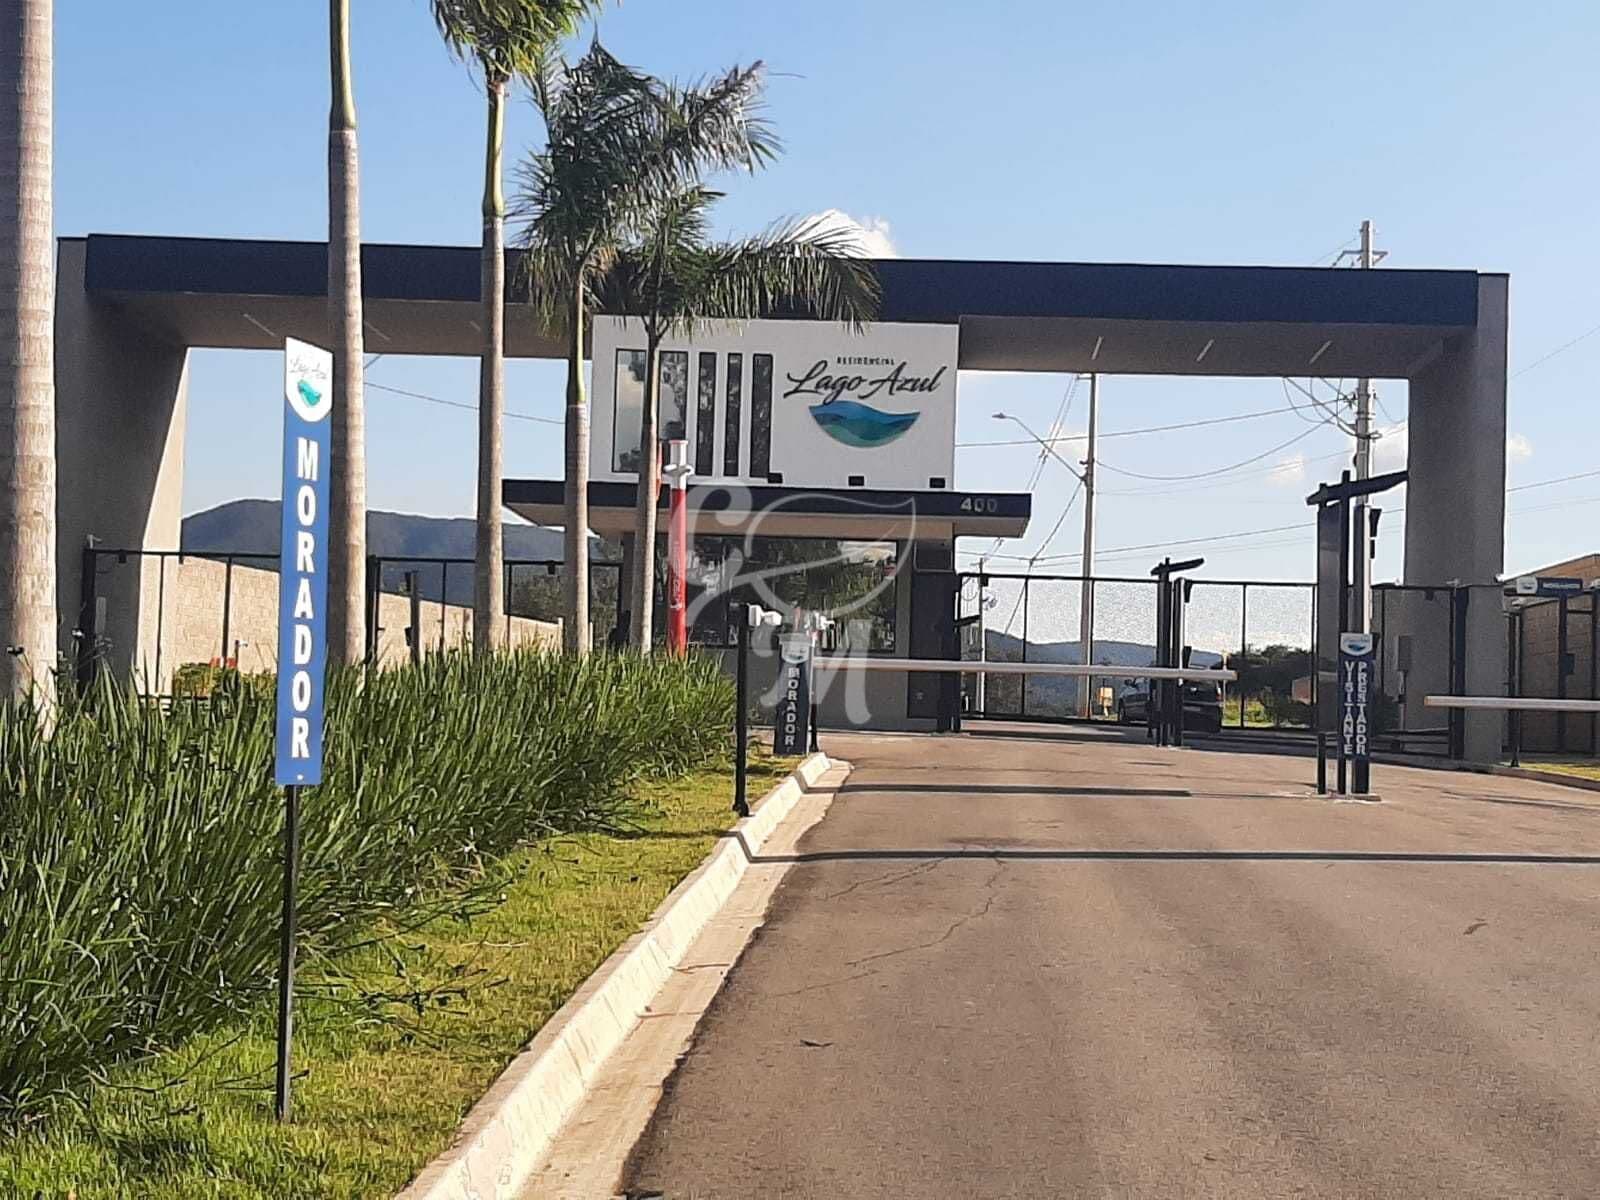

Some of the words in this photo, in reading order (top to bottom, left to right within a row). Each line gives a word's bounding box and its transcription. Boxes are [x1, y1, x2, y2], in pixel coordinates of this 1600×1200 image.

[783, 359, 867, 405] Lago
[858, 361, 948, 399] Azul
[960, 497, 998, 512] 400
[291, 436, 319, 759] MORADOR
[784, 667, 800, 746] MORADOR
[1344, 661, 1355, 755] VISITANTE
[1356, 661, 1367, 755] PRESTADOR
